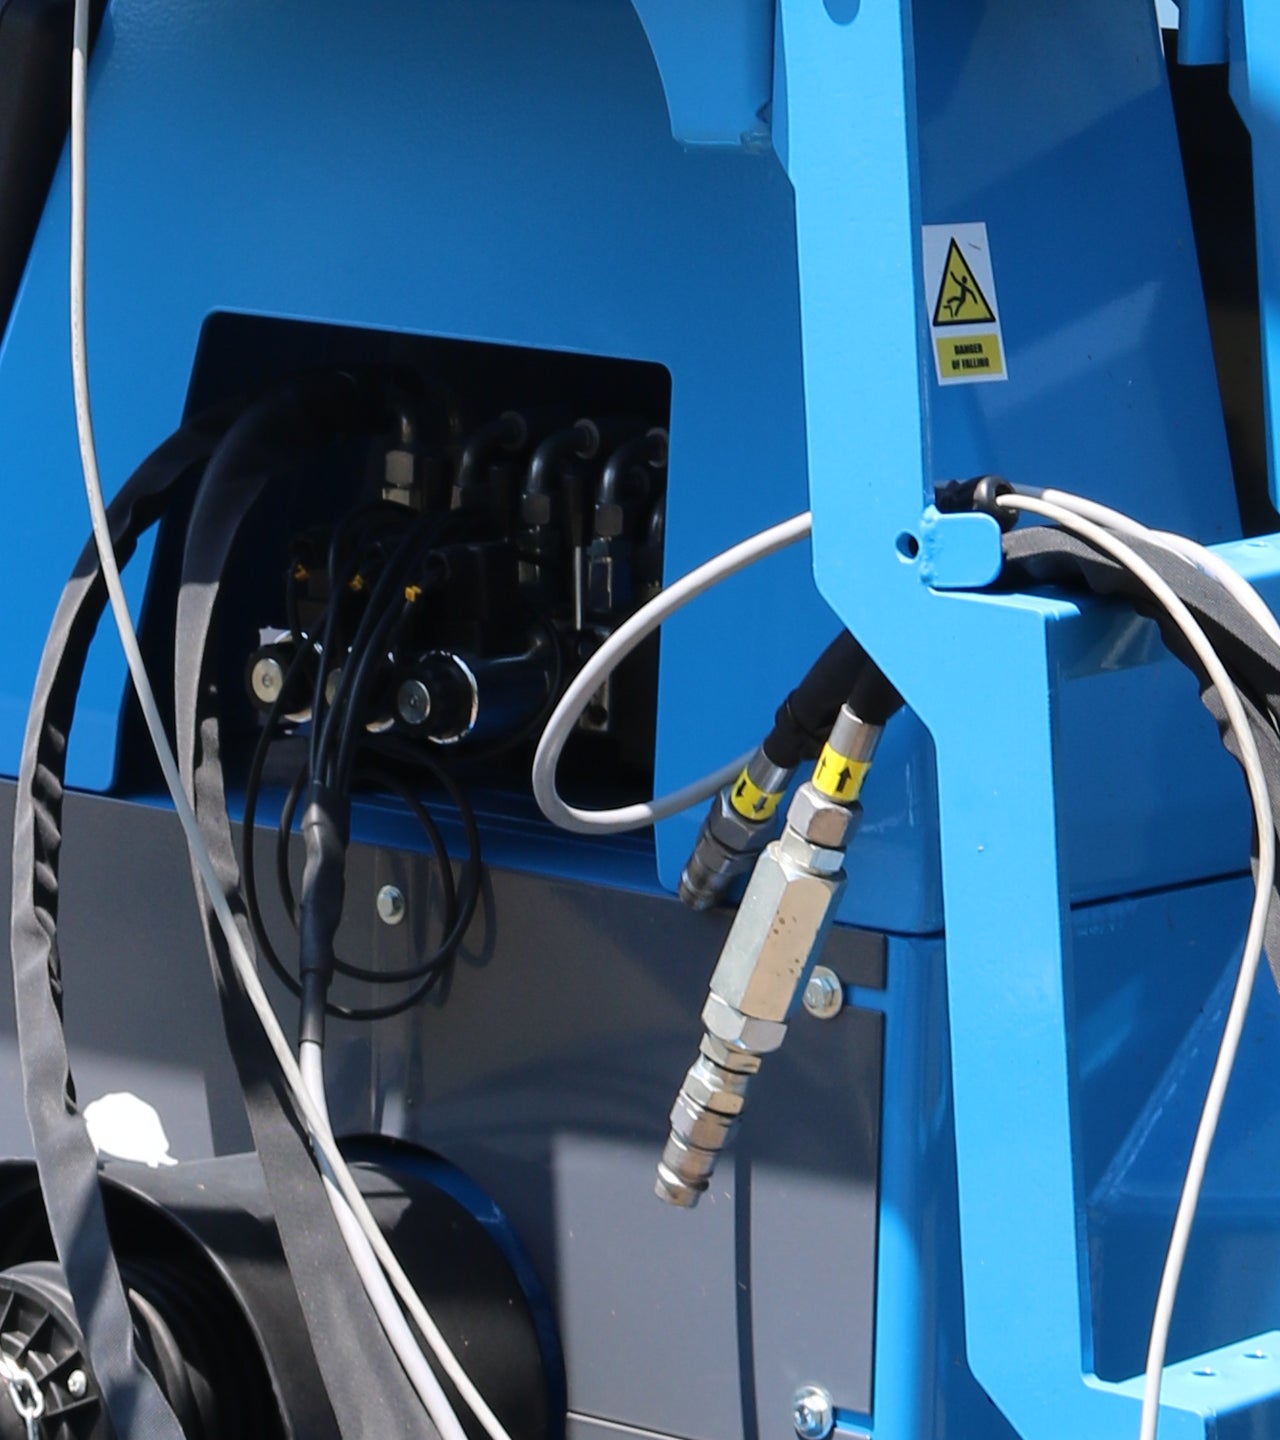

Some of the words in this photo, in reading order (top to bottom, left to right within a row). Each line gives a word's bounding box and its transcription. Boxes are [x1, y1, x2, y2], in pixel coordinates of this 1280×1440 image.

[954, 343, 983, 355] DANGER
[951, 359, 960, 370] OF
[961, 357, 990, 369] FALLING
